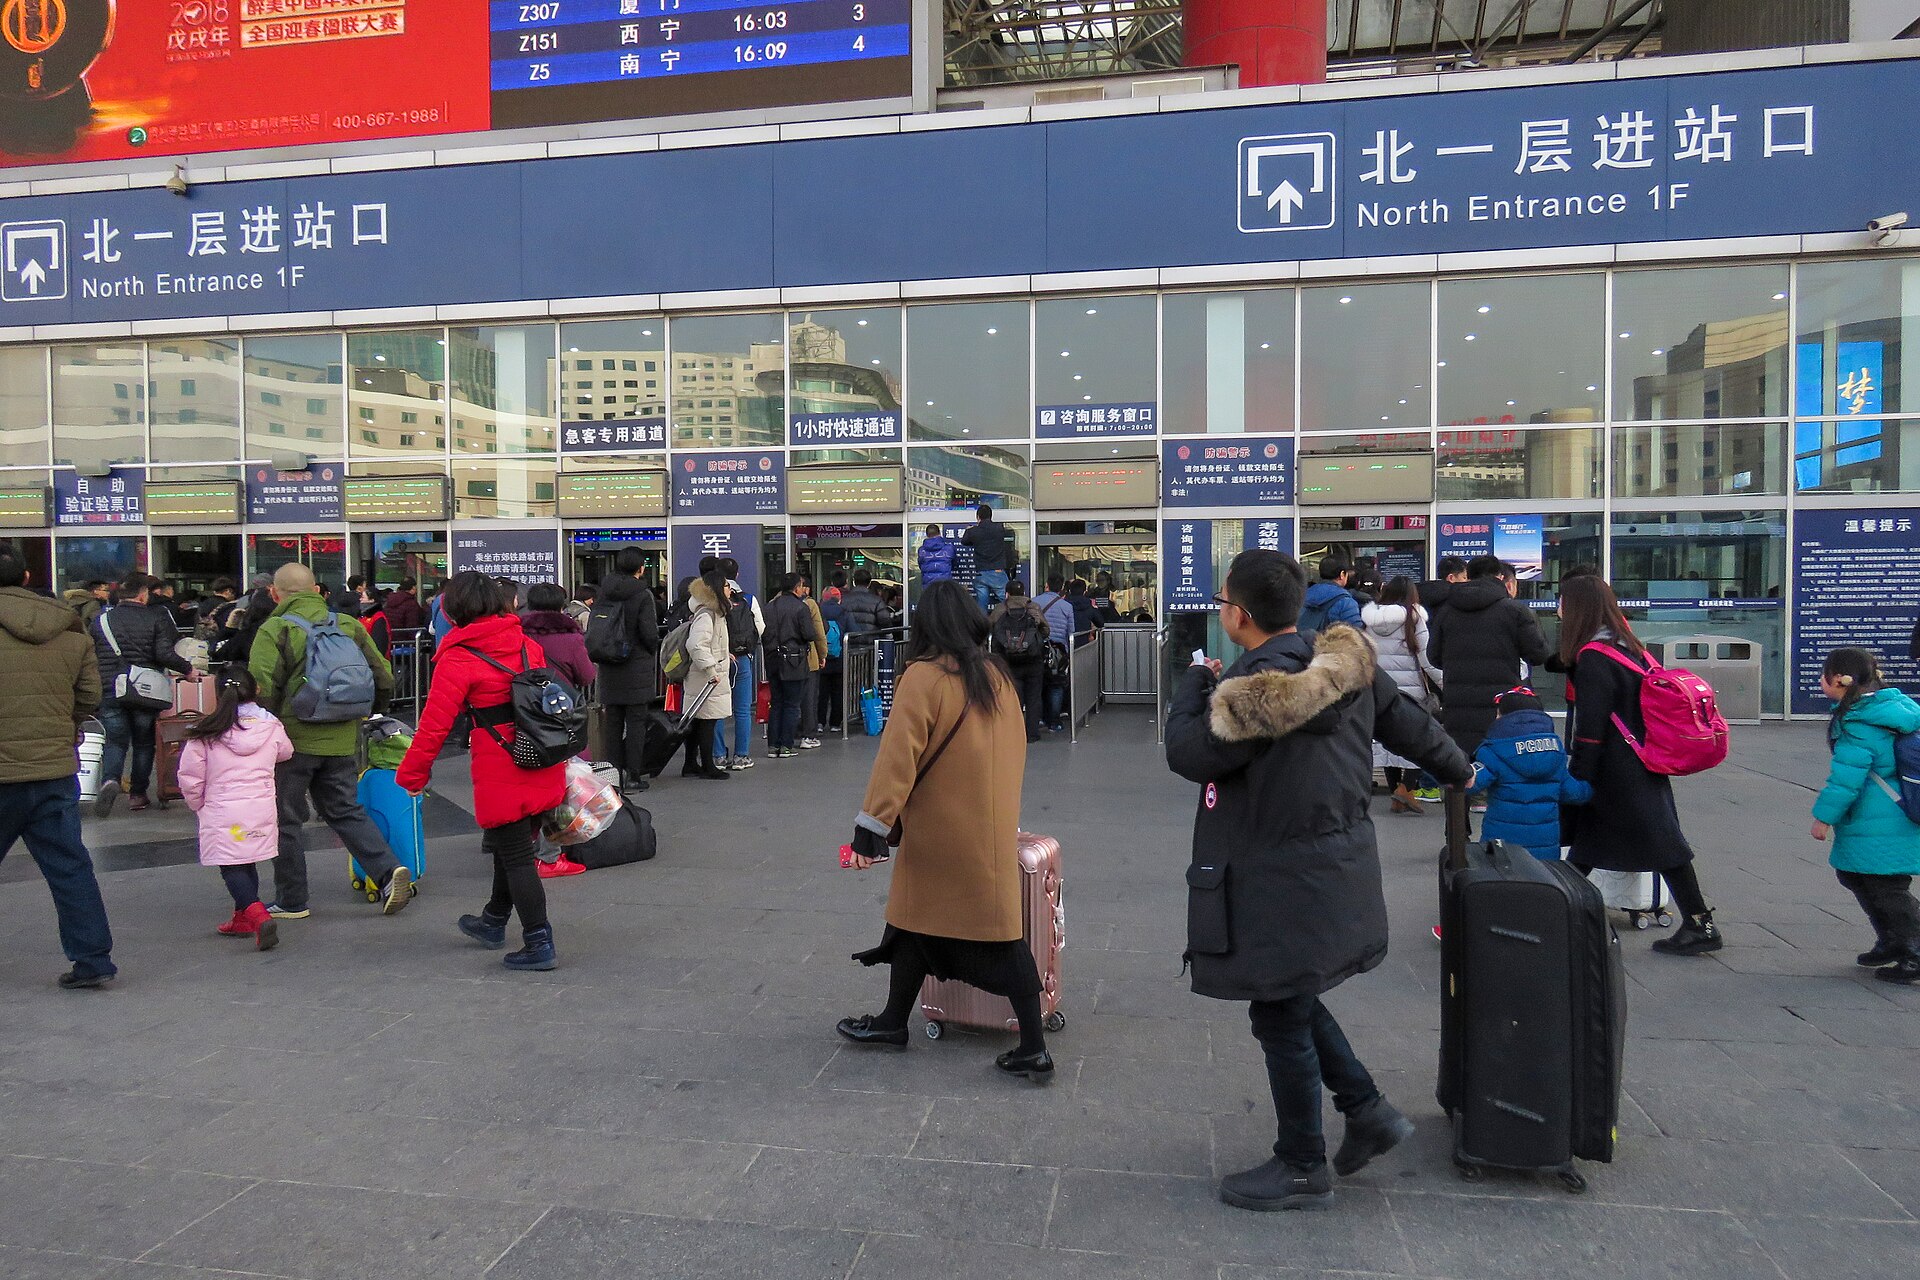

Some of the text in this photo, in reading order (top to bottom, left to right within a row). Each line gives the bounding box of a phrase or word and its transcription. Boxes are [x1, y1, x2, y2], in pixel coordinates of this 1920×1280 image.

[170, 1, 229, 26] 2018
[519, 3, 560, 22] Z307
[166, 26, 230, 50] 戊戌年
[248, 13, 398, 42] 全国迎春楹联大赛
[519, 4, 864, 52] Z151 西宁 16:03 3
[529, 36, 864, 81] Z5 南宁 16:09 4
[333, 108, 439, 129] 400-667-1988
[1359, 105, 1815, 185] 北一层进站口
[1358, 183, 1690, 227] North Entrance 1F
[82, 201, 388, 264] 北一层进站口
[83, 265, 305, 298] North Entrance 1F
[1838, 367, 1875, 414] 梦
[1060, 408, 1152, 424] 咨询服务窗口
[565, 425, 664, 445] 急客专用通道
[795, 417, 895, 438] 1小时快速通道
[1205, 446, 1250, 459] 防骗警示
[708, 460, 748, 471] 防骗警示
[77, 477, 125, 494] 自助
[65, 496, 139, 512] 验证验票口
[1845, 519, 1912, 532] 温馨提示
[475, 552, 554, 562] 乘坐市郊铁路城市副
[702, 534, 732, 558] 军
[1181, 524, 1194, 585] 咨询服务窗口
[459, 564, 555, 573] 中心线的旅客请到北广场
